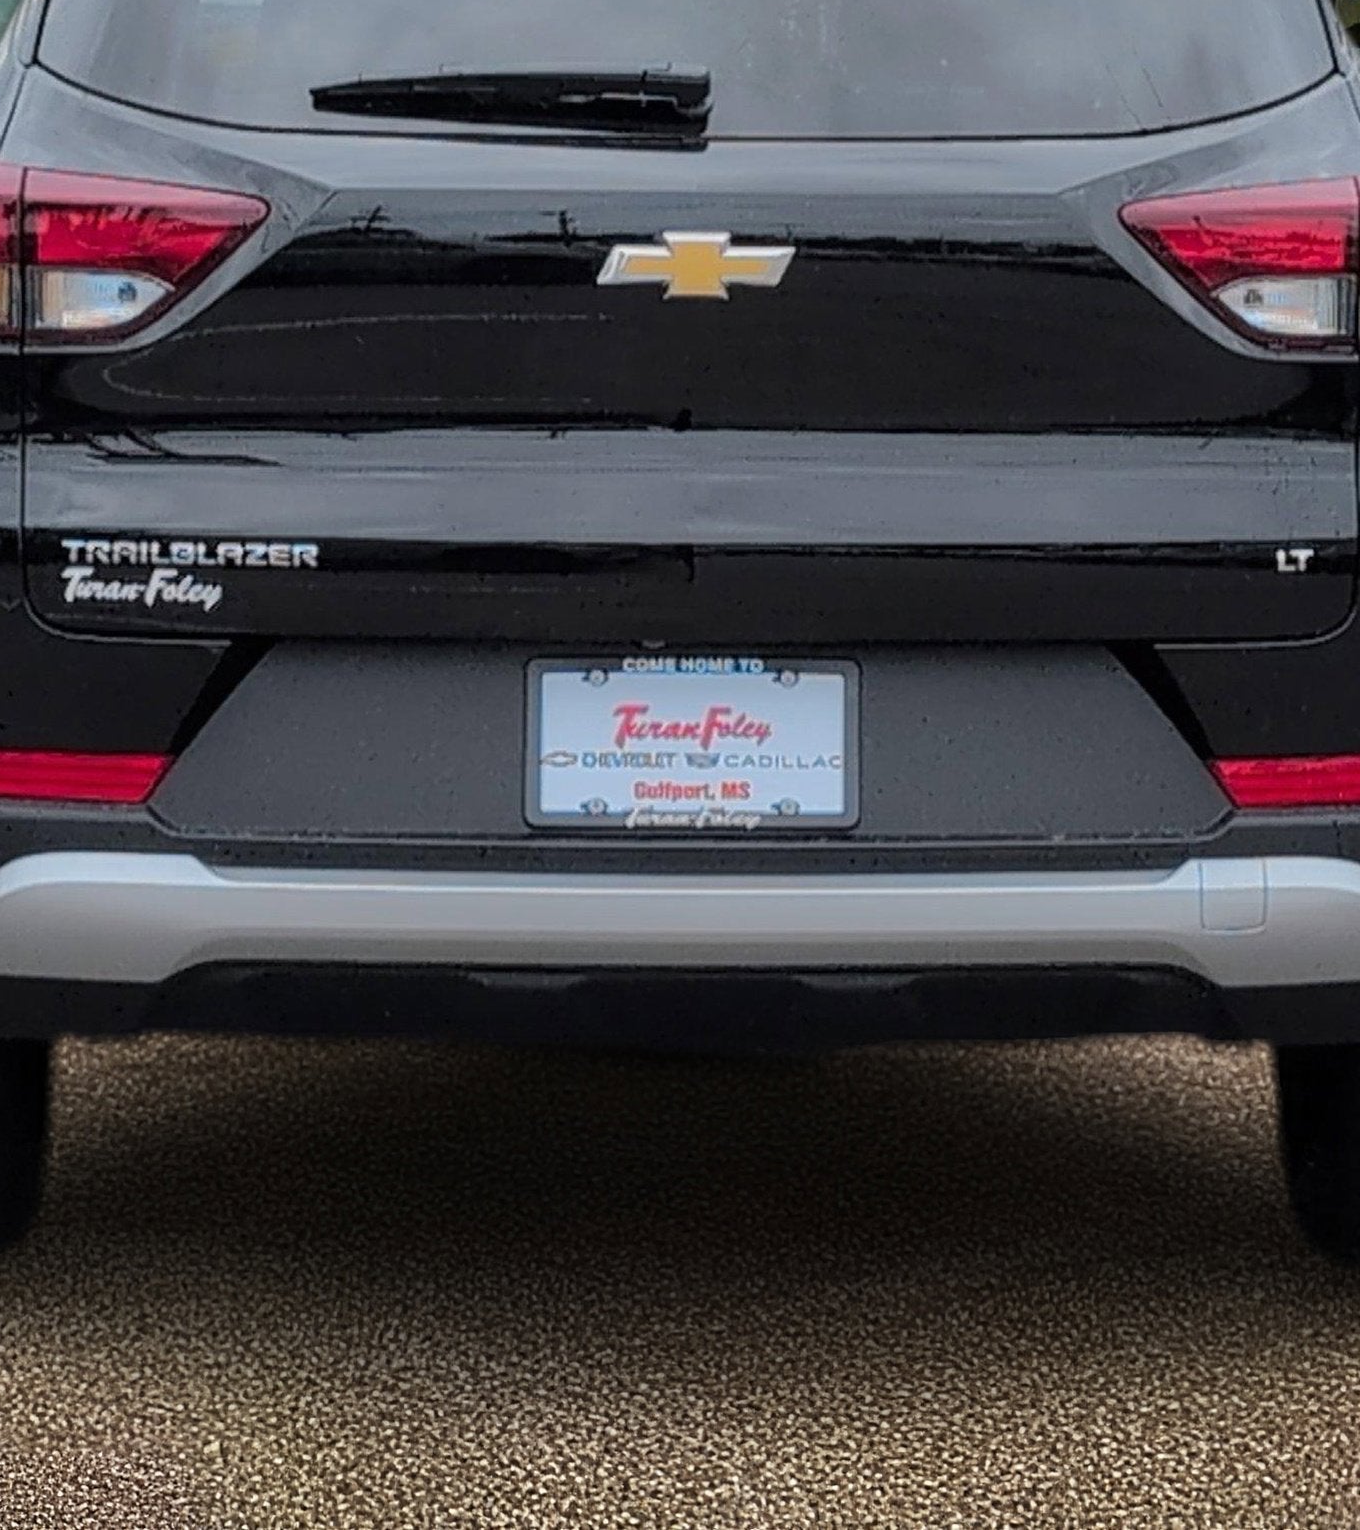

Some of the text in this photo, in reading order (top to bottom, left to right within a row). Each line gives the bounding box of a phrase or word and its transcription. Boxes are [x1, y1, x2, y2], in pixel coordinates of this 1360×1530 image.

[61, 538, 320, 568] TRAILBLAZER
[1275, 549, 1315, 572] LT
[740, 658, 765, 673] TO
[724, 753, 840, 770] CADILLAC
[721, 781, 751, 801] MS
